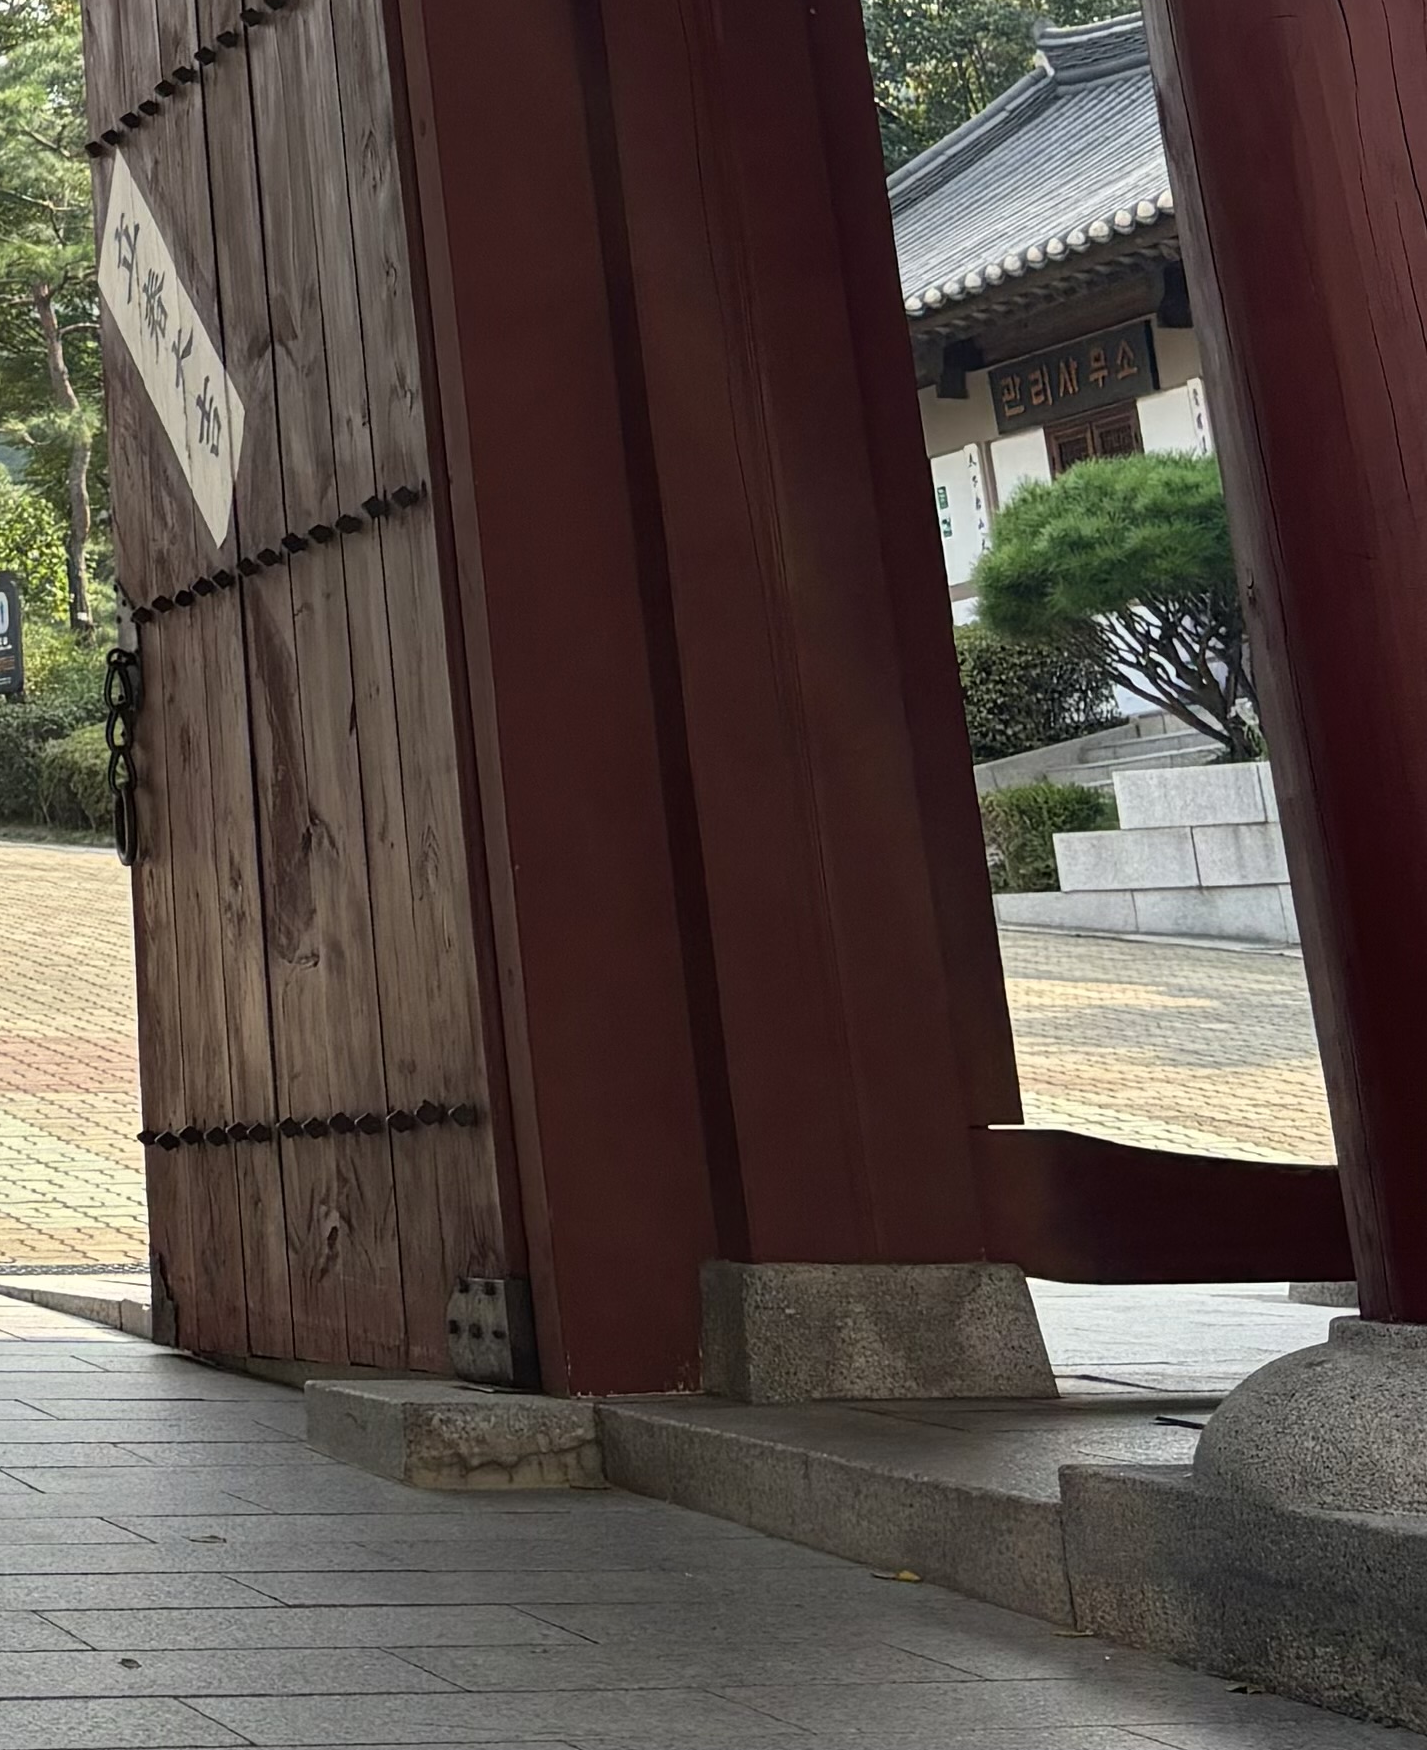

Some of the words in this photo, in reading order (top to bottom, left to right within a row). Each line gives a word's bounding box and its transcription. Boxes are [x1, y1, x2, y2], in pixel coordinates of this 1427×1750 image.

[114, 212, 222, 457] 立春大吉
[1001, 340, 1138, 418] 관리사무소
